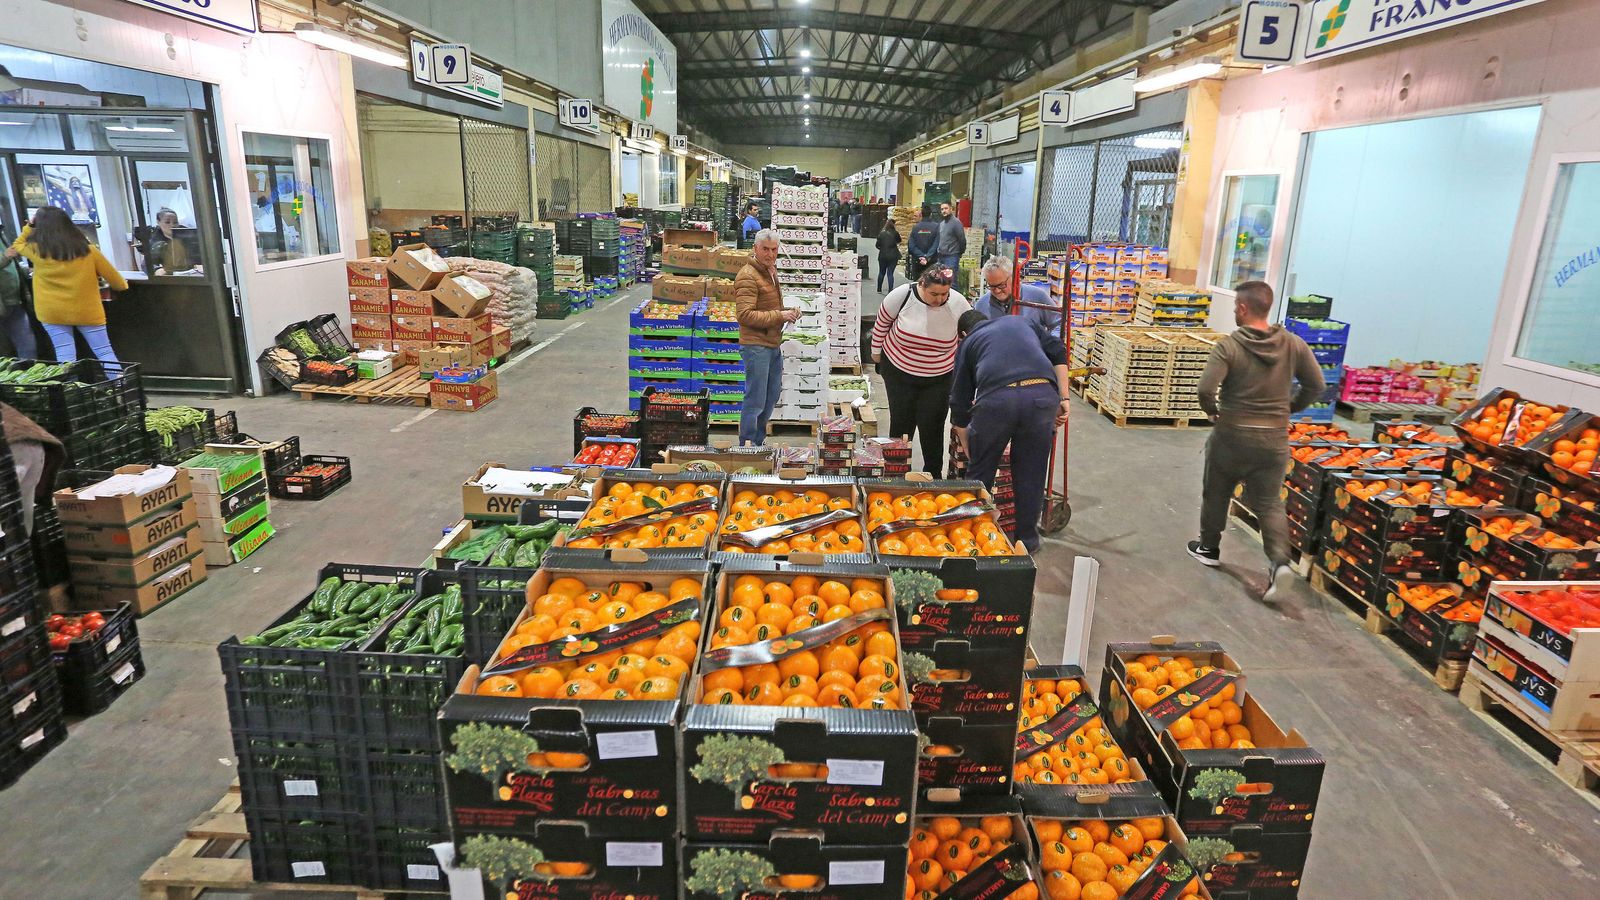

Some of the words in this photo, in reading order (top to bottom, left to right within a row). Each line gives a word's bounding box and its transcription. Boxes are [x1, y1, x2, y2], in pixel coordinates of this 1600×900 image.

[1259, 16, 1279, 45] 5
[418, 51, 426, 71] 9
[443, 55, 457, 75] 9
[571, 105, 588, 119] 10
[1050, 100, 1062, 116] 4
[640, 127, 651, 138] 11
[975, 128, 983, 140] 3
[675, 139, 685, 148] 12
[914, 165, 918, 173] 1
[351, 278, 383, 287] BANAMIEL
[352, 303, 385, 313] BANAMIEL
[395, 305, 428, 316] BANAMIEL
[354, 329, 387, 339] BANAMIEL
[395, 330, 427, 341] BANAMIEL
[435, 333, 468, 342] BANAMIEL
[141, 483, 179, 513] AYATI
[487, 496, 522, 513] AYA
[59, 501, 87, 512] AYATI
[147, 512, 184, 543] AYATI
[152, 541, 189, 573] AYATI
[156, 569, 193, 602] AYATI
[1537, 631, 1563, 651] JVS
[1521, 675, 1547, 697] JVS
[511, 786, 554, 801] Plaza
[587, 784, 660, 799] Sabrosas
[752, 795, 796, 811] Plaza
[829, 793, 900, 807] Sabrosas
[576, 802, 601, 816] del
[605, 802, 668, 821] Campo
[817, 810, 842, 824] del
[846, 810, 907, 827] Campo
